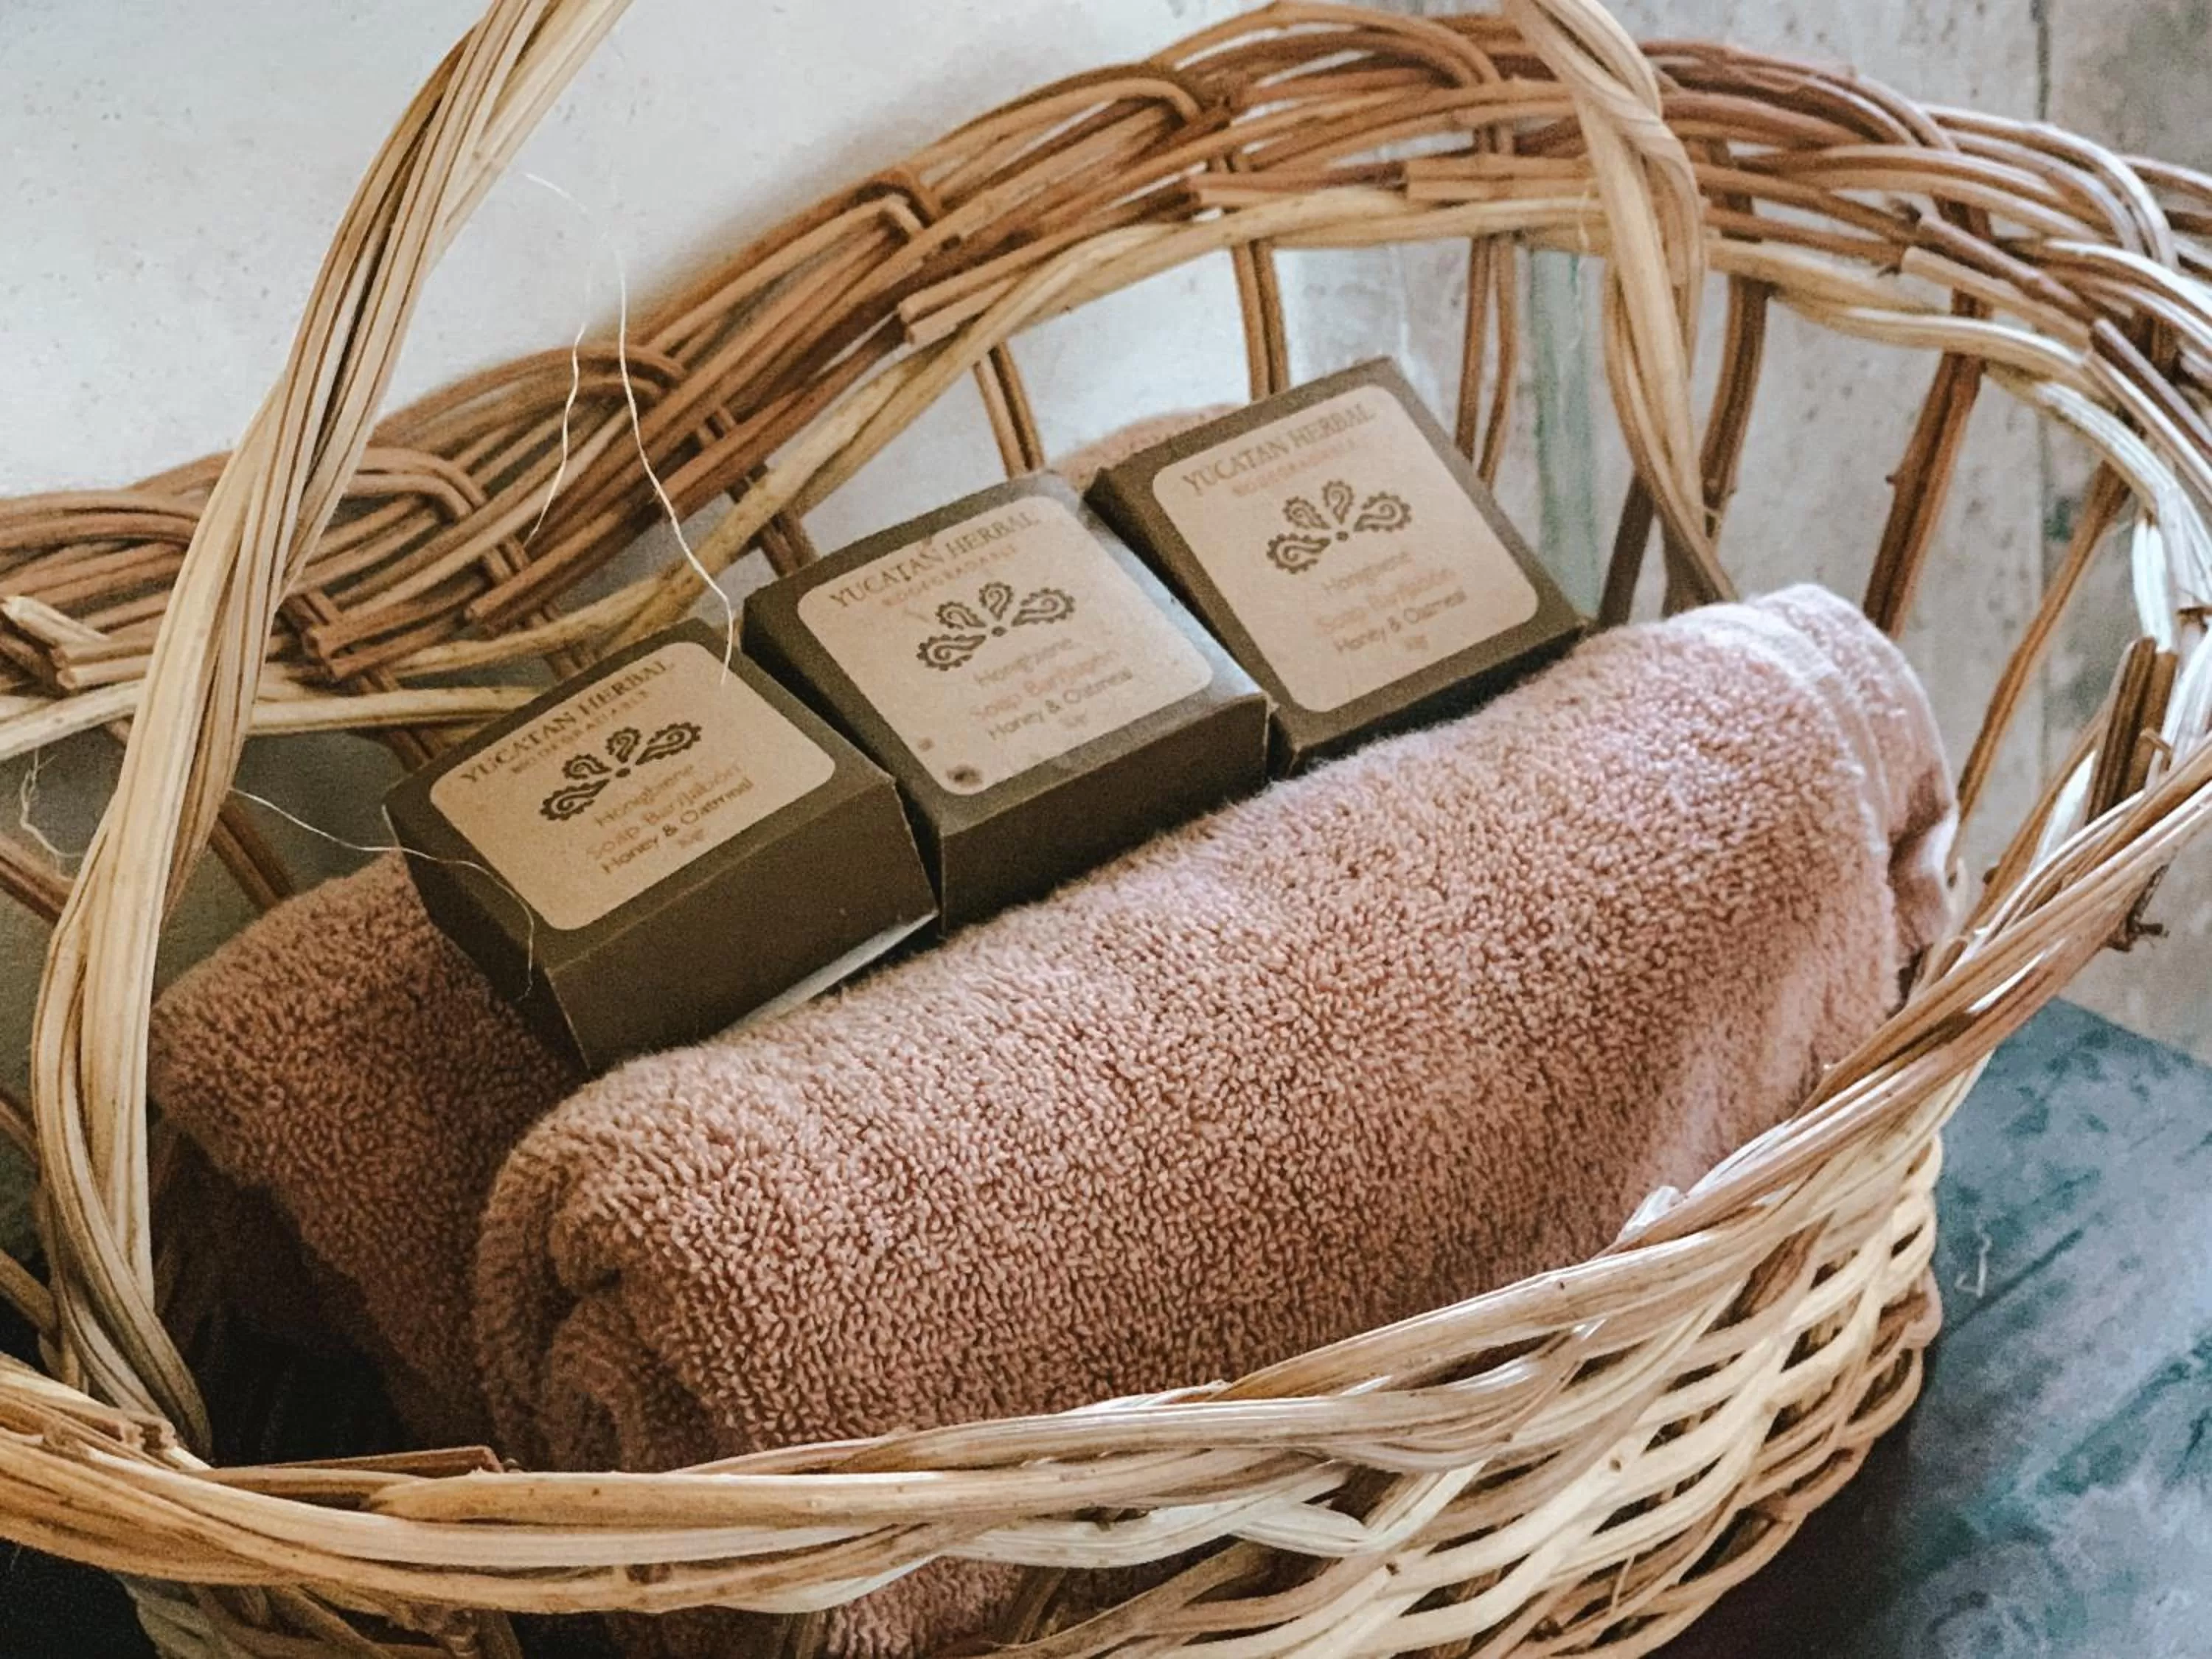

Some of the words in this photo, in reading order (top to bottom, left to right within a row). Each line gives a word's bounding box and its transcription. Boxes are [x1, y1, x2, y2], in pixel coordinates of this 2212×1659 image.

[1382, 613, 1404, 633] &
[457, 712, 580, 785] YUCATAN
[576, 657, 675, 715] HERBAL
[986, 709, 1047, 742] Honey
[1040, 698, 1064, 715] &
[599, 835, 661, 874] Honey
[658, 821, 681, 838] &
[678, 779, 756, 826] Oatmeal
